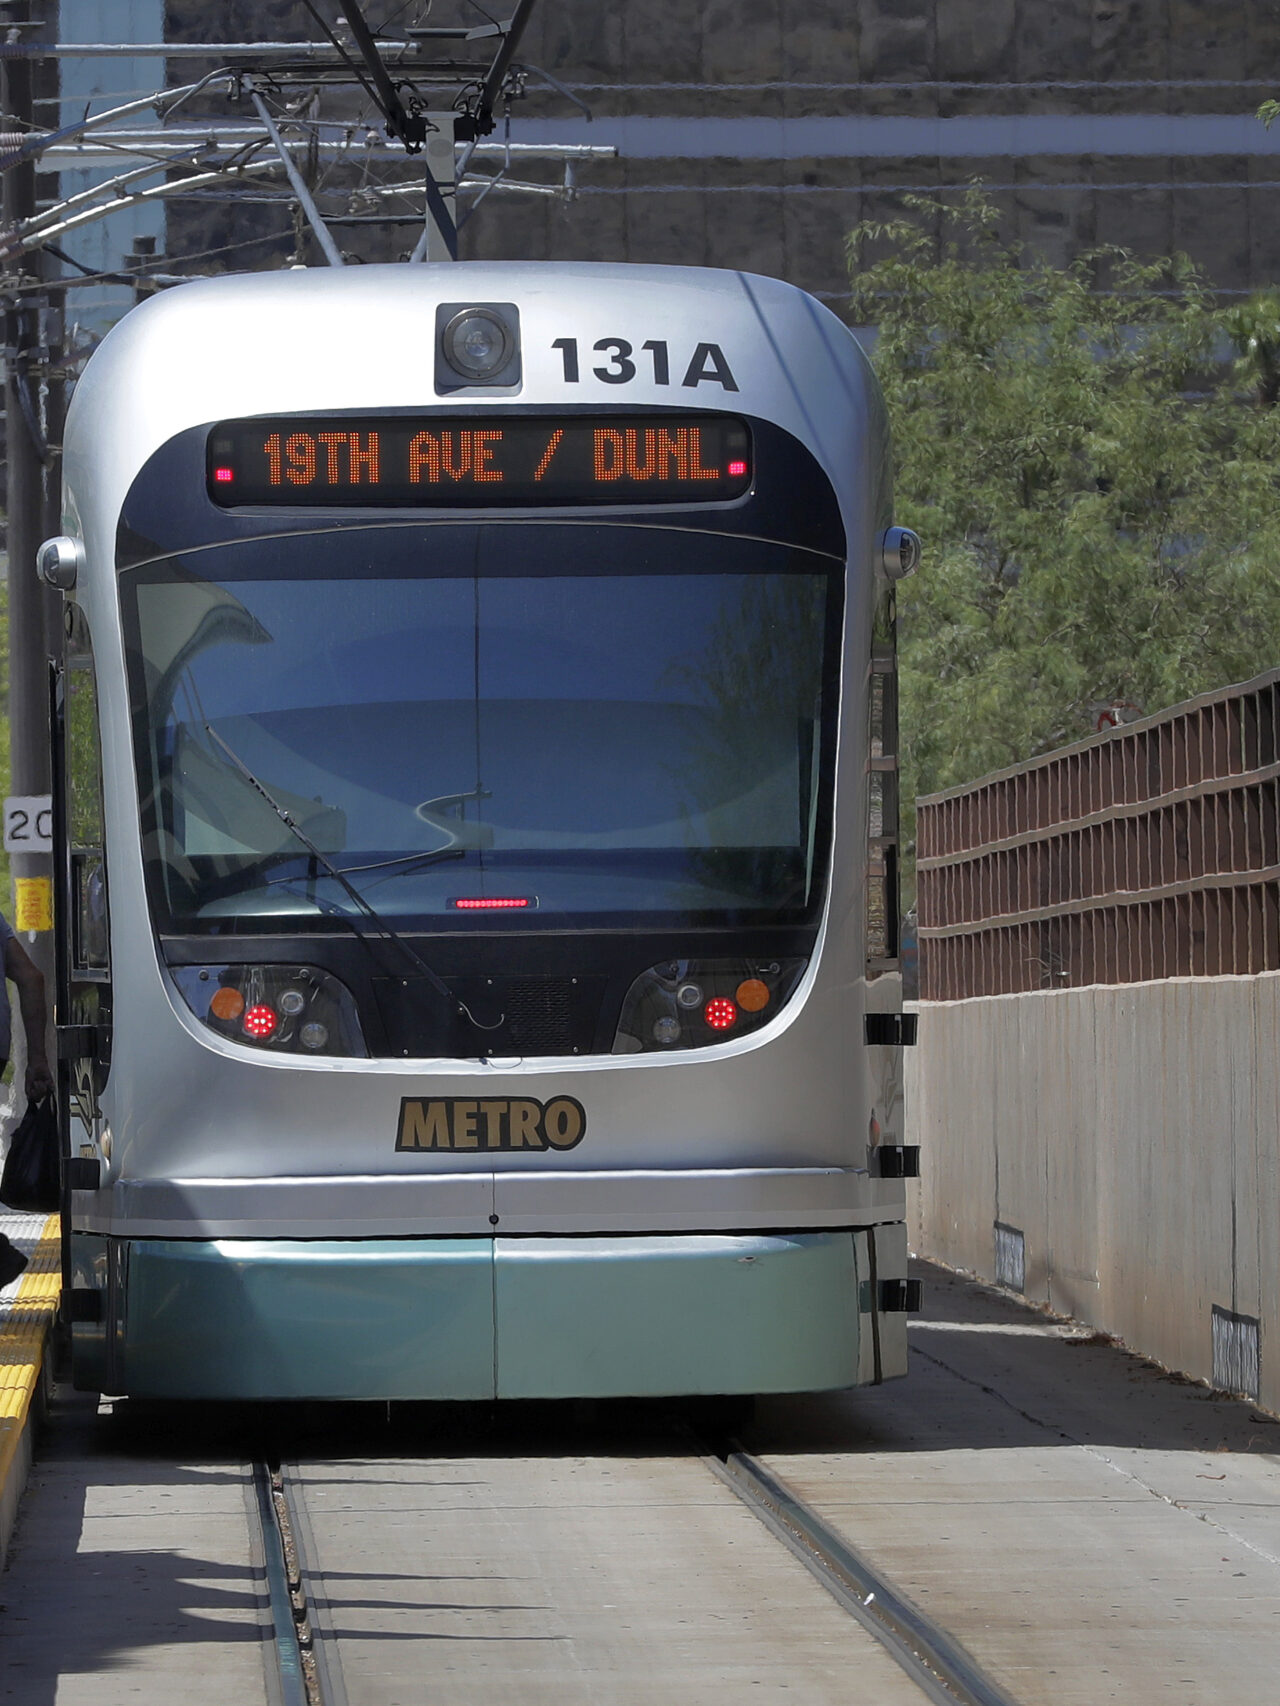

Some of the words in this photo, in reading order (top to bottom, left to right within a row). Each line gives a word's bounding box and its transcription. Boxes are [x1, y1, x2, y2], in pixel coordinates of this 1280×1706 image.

[551, 337, 741, 393] 131A
[263, 430, 380, 485] 19TH
[409, 430, 503, 483] AVE
[534, 428, 563, 482] /
[593, 426, 720, 481] DUNL
[398, 1098, 583, 1150] METRO
